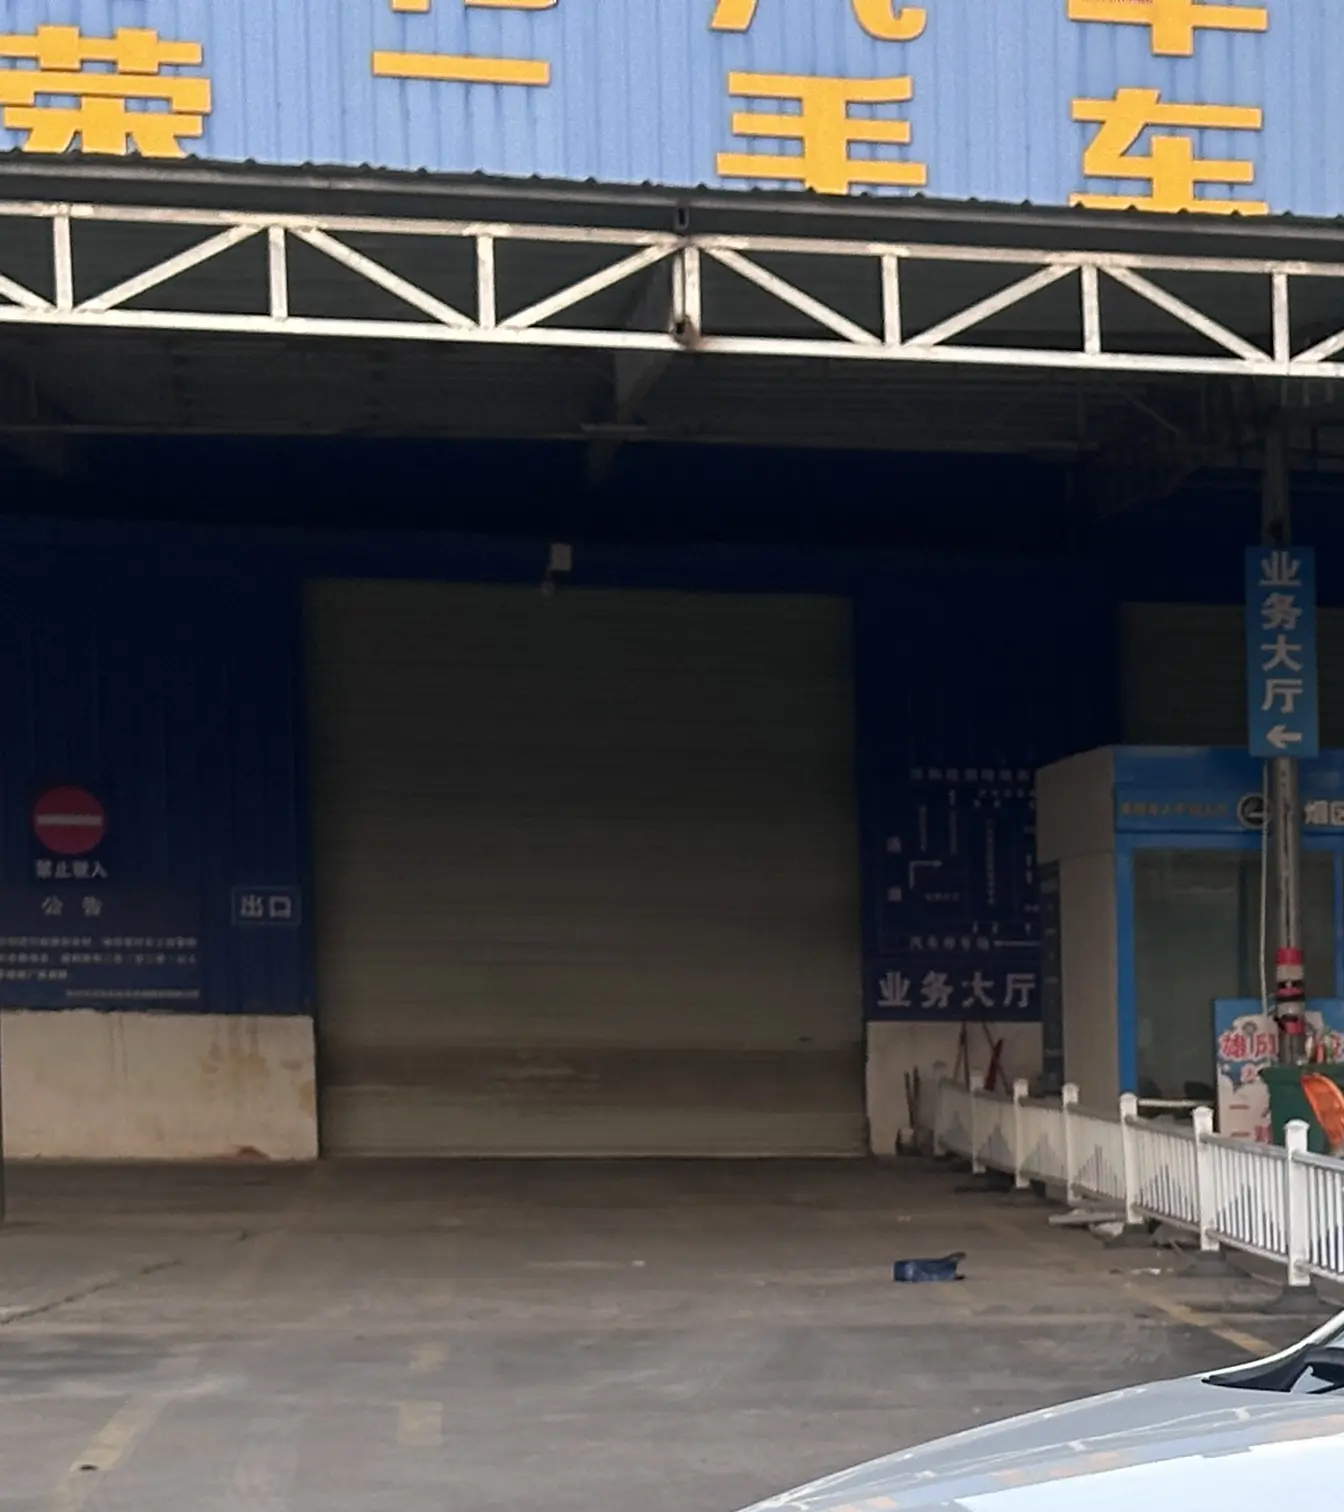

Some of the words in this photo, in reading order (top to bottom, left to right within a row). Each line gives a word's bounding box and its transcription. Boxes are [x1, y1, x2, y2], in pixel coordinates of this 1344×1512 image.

[1258, 550, 1304, 714] 业务大厅
[240, 894, 292, 919] 出口
[876, 970, 1037, 1009] 业务大厅
